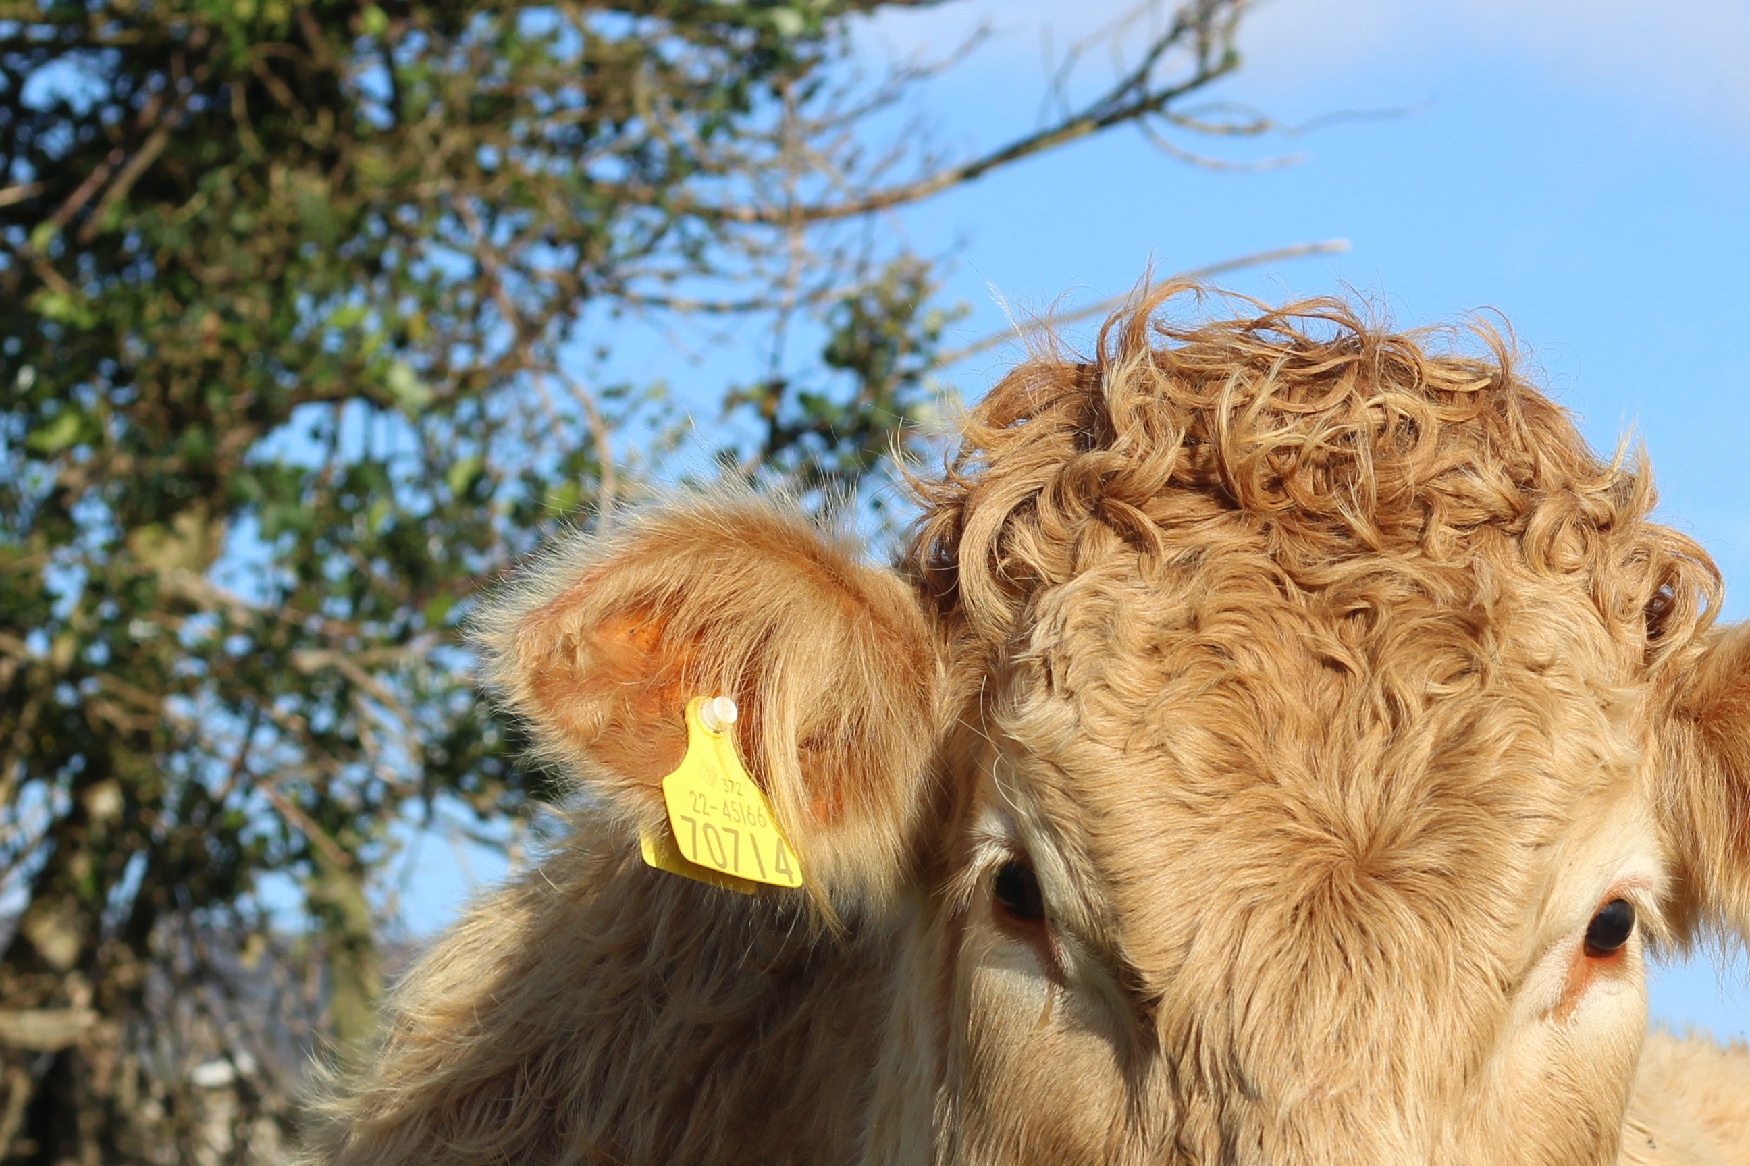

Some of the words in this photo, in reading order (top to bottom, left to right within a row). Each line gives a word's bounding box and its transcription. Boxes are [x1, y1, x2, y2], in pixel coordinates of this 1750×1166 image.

[722, 779, 744, 796] 372
[689, 790, 767, 828] 22-45166
[681, 815, 793, 883] 70714
